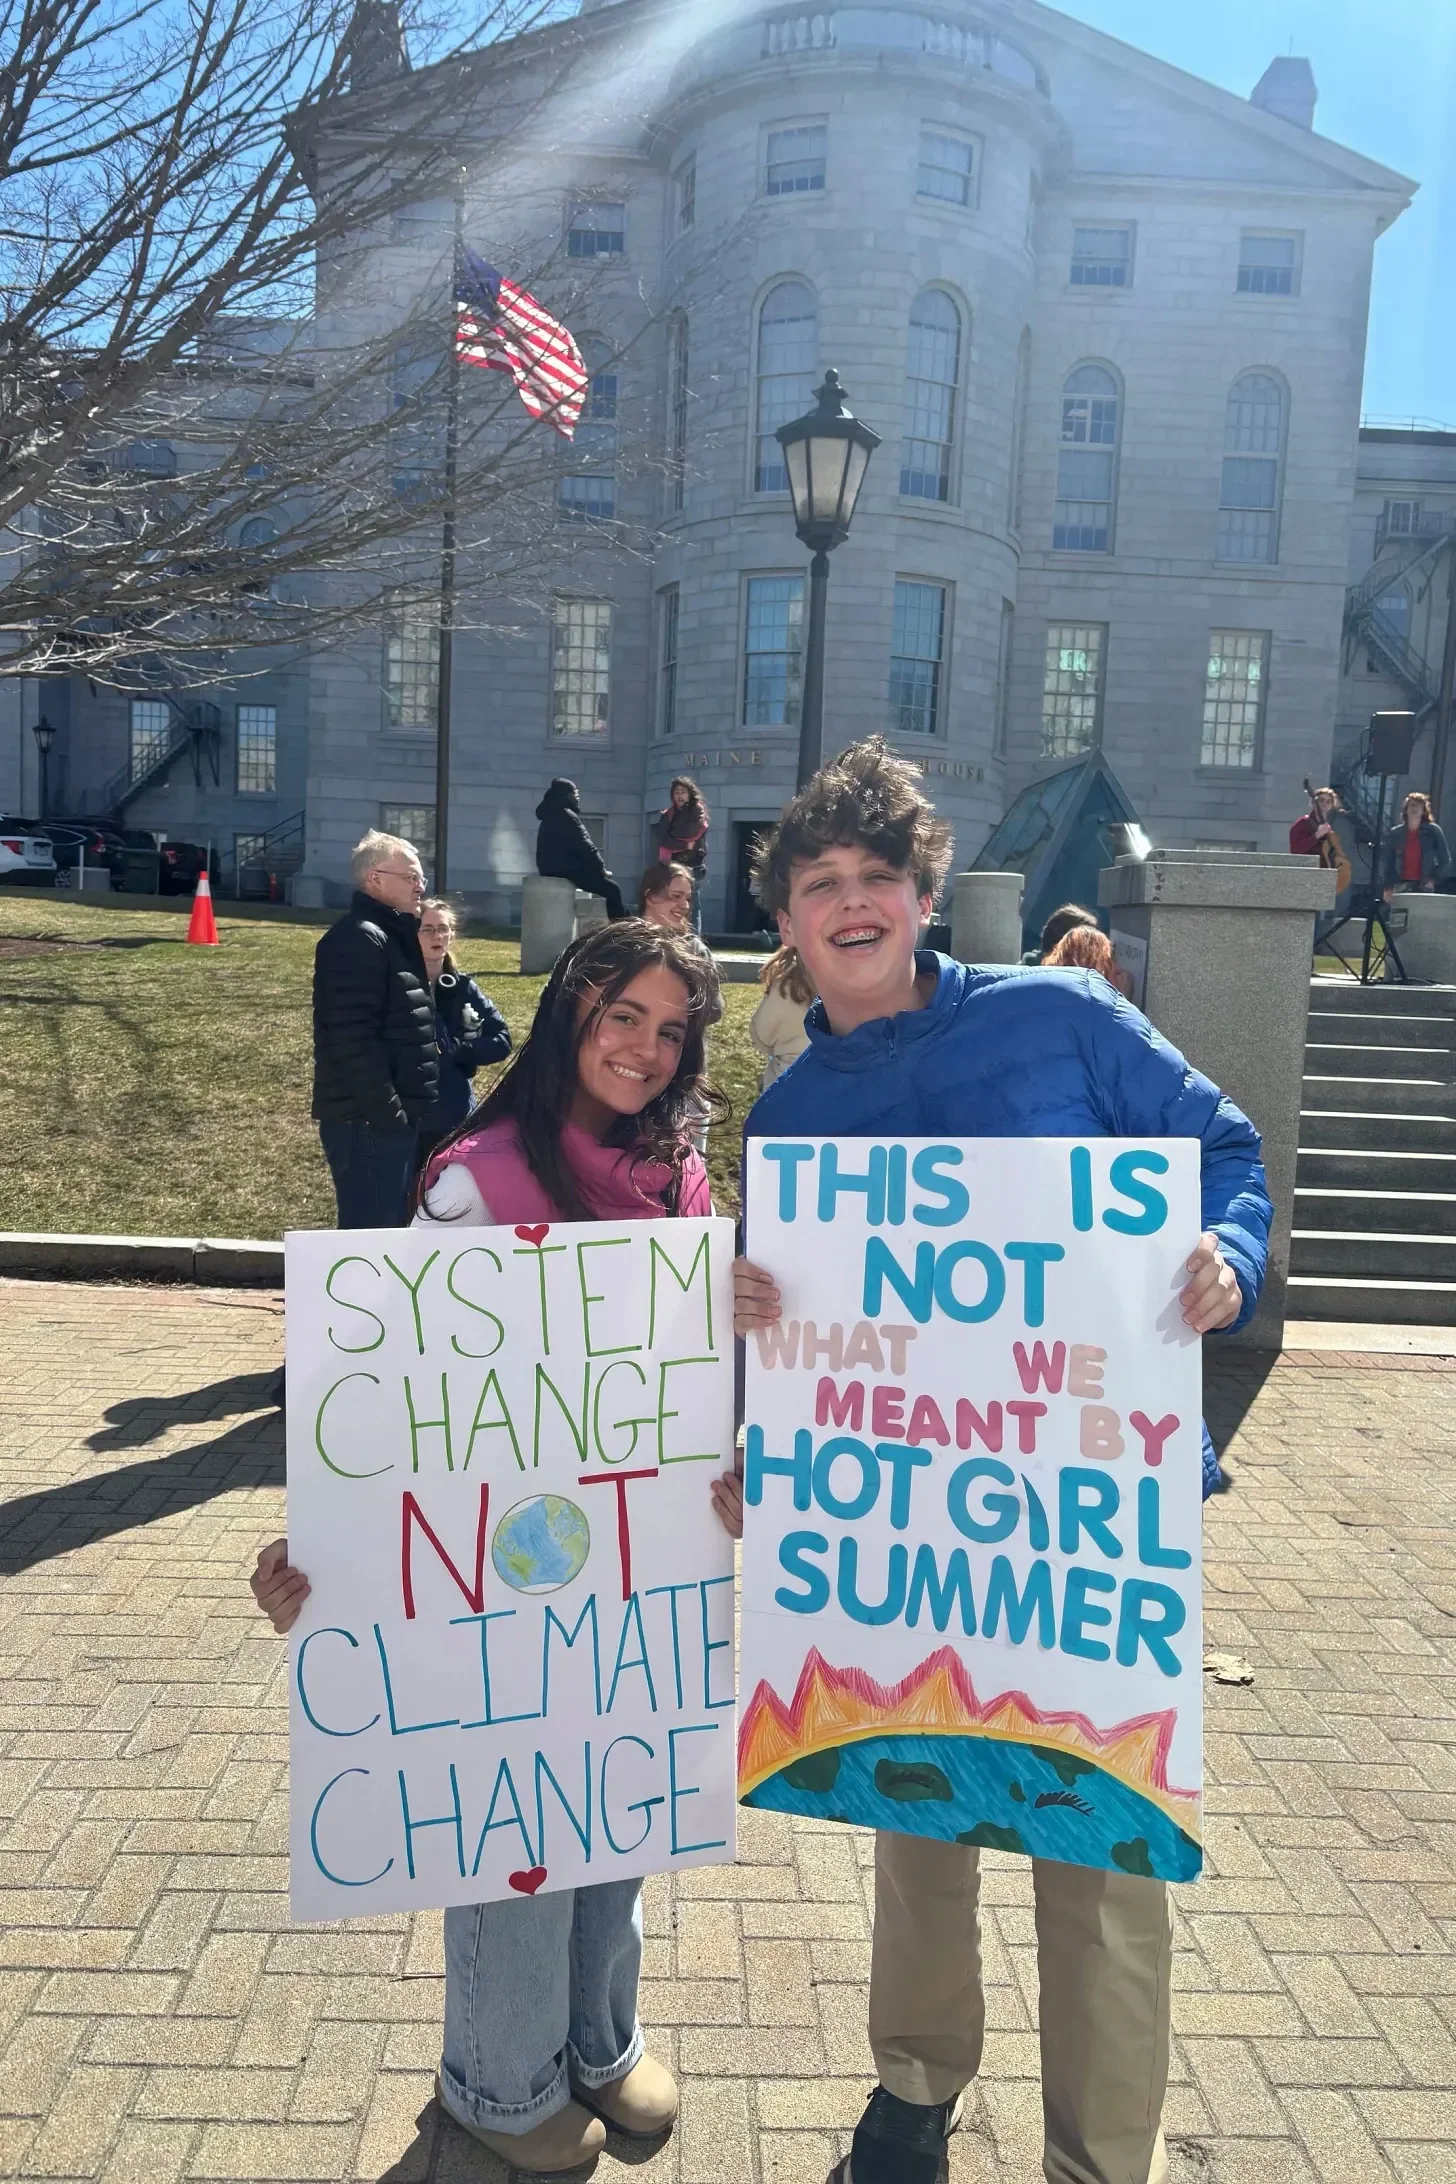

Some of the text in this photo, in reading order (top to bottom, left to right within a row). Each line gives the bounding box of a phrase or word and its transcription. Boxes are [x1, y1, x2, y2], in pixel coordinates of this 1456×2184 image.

[685, 751, 985, 782] MAINE HOUSE
[762, 1143, 1169, 1236] THIS IS
[326, 1232, 714, 1358] SYSTEM
[863, 1236, 1065, 1328] NOT
[316, 1357, 720, 1478] CHANGE
[754, 1319, 1108, 1400] WHAT WE
[815, 1376, 1180, 1467] MEANT BY
[744, 1424, 1192, 1570] HOT GIRL
[297, 1575, 736, 1737] CLIMATE
[774, 1530, 1187, 1677] SUMMER
[311, 1723, 727, 1886] CHANGE
